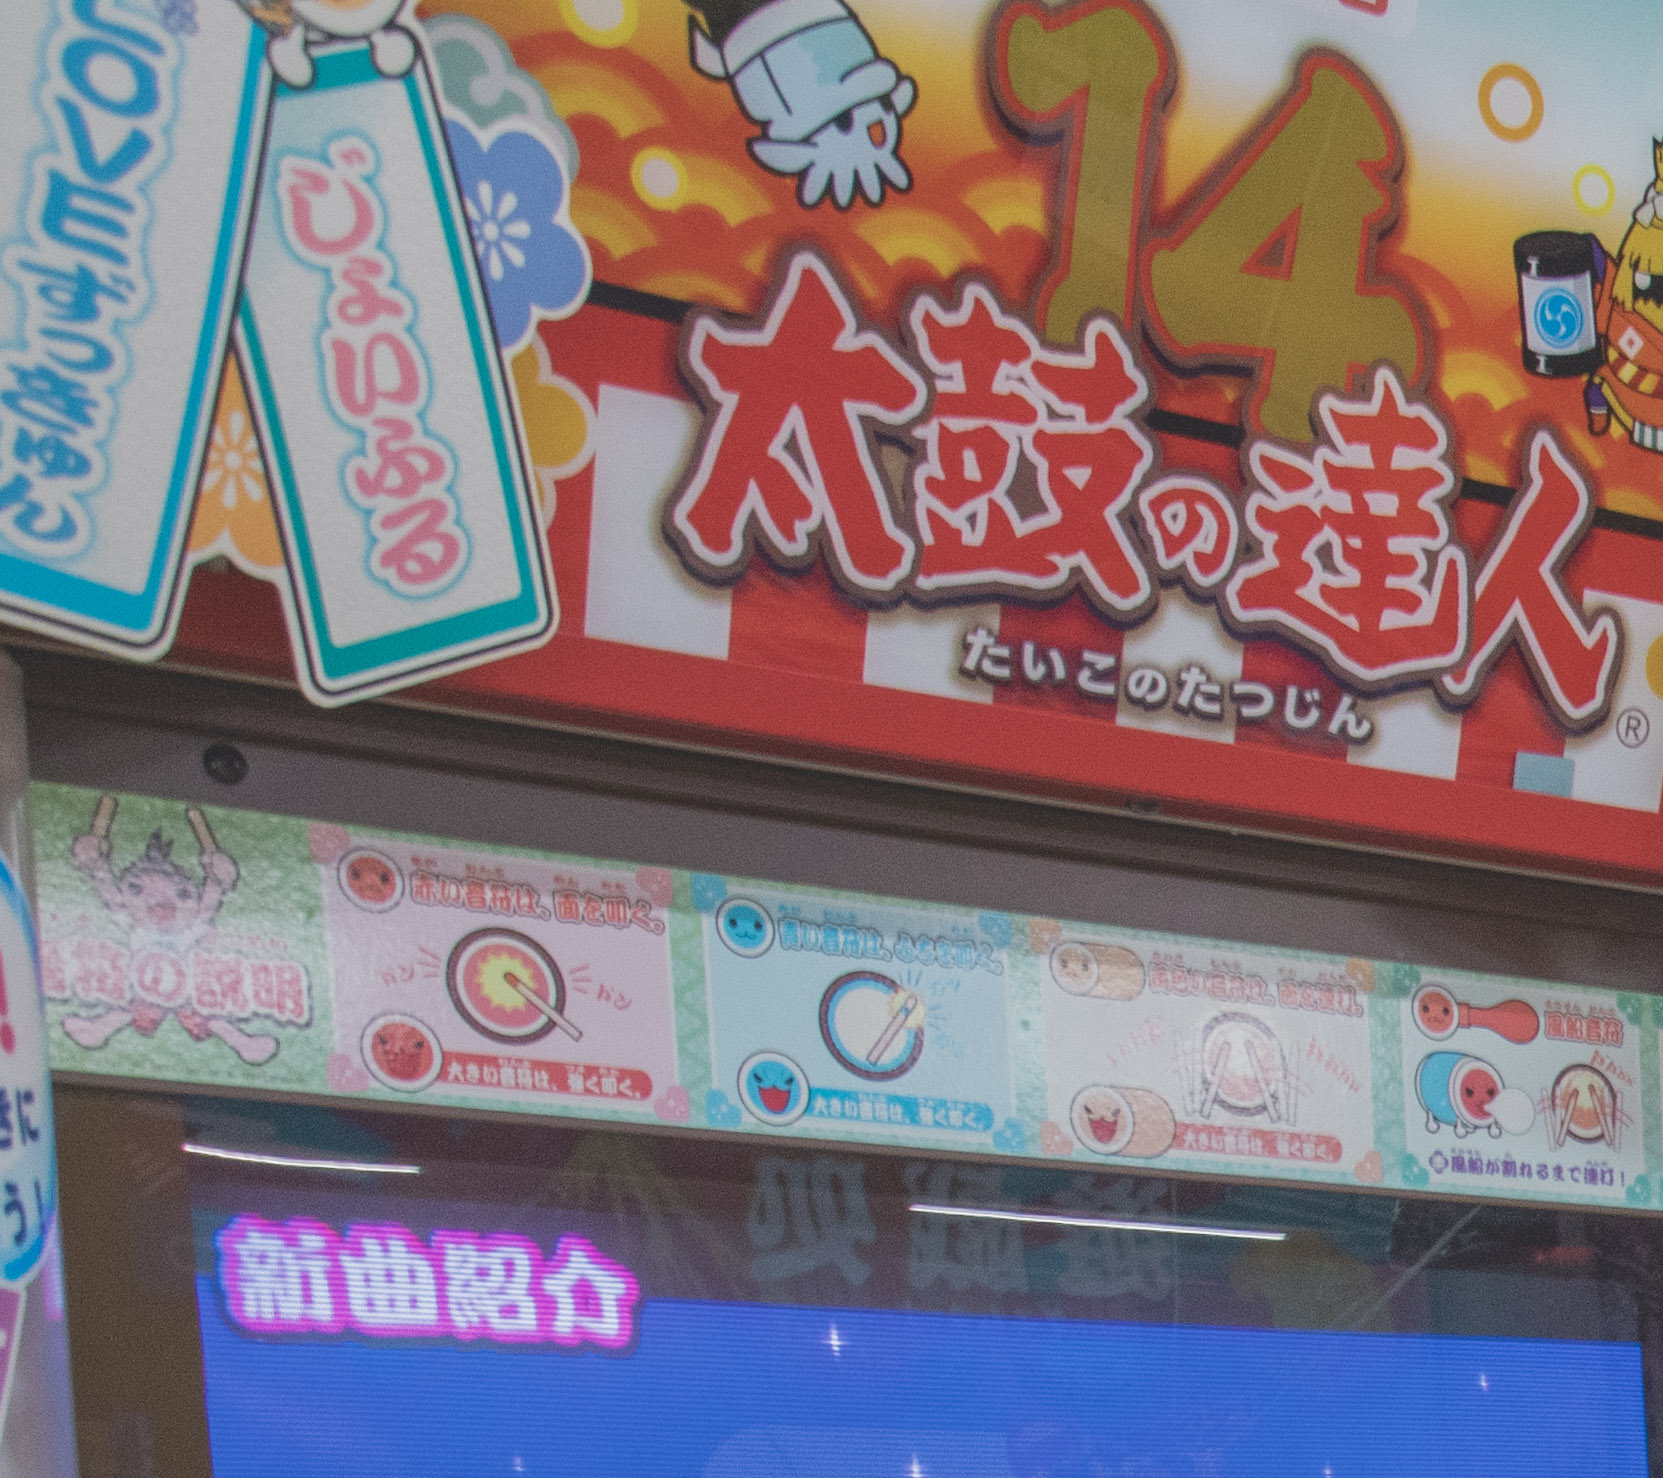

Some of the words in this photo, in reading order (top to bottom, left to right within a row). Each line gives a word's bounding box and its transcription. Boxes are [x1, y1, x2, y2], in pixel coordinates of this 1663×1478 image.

[1000, 4, 1418, 442] 14
[672, 253, 1618, 722] 太鼓の達人
[961, 626, 1376, 740] たいこのたつじん
[230, 1223, 637, 1343] 新曲紹介
